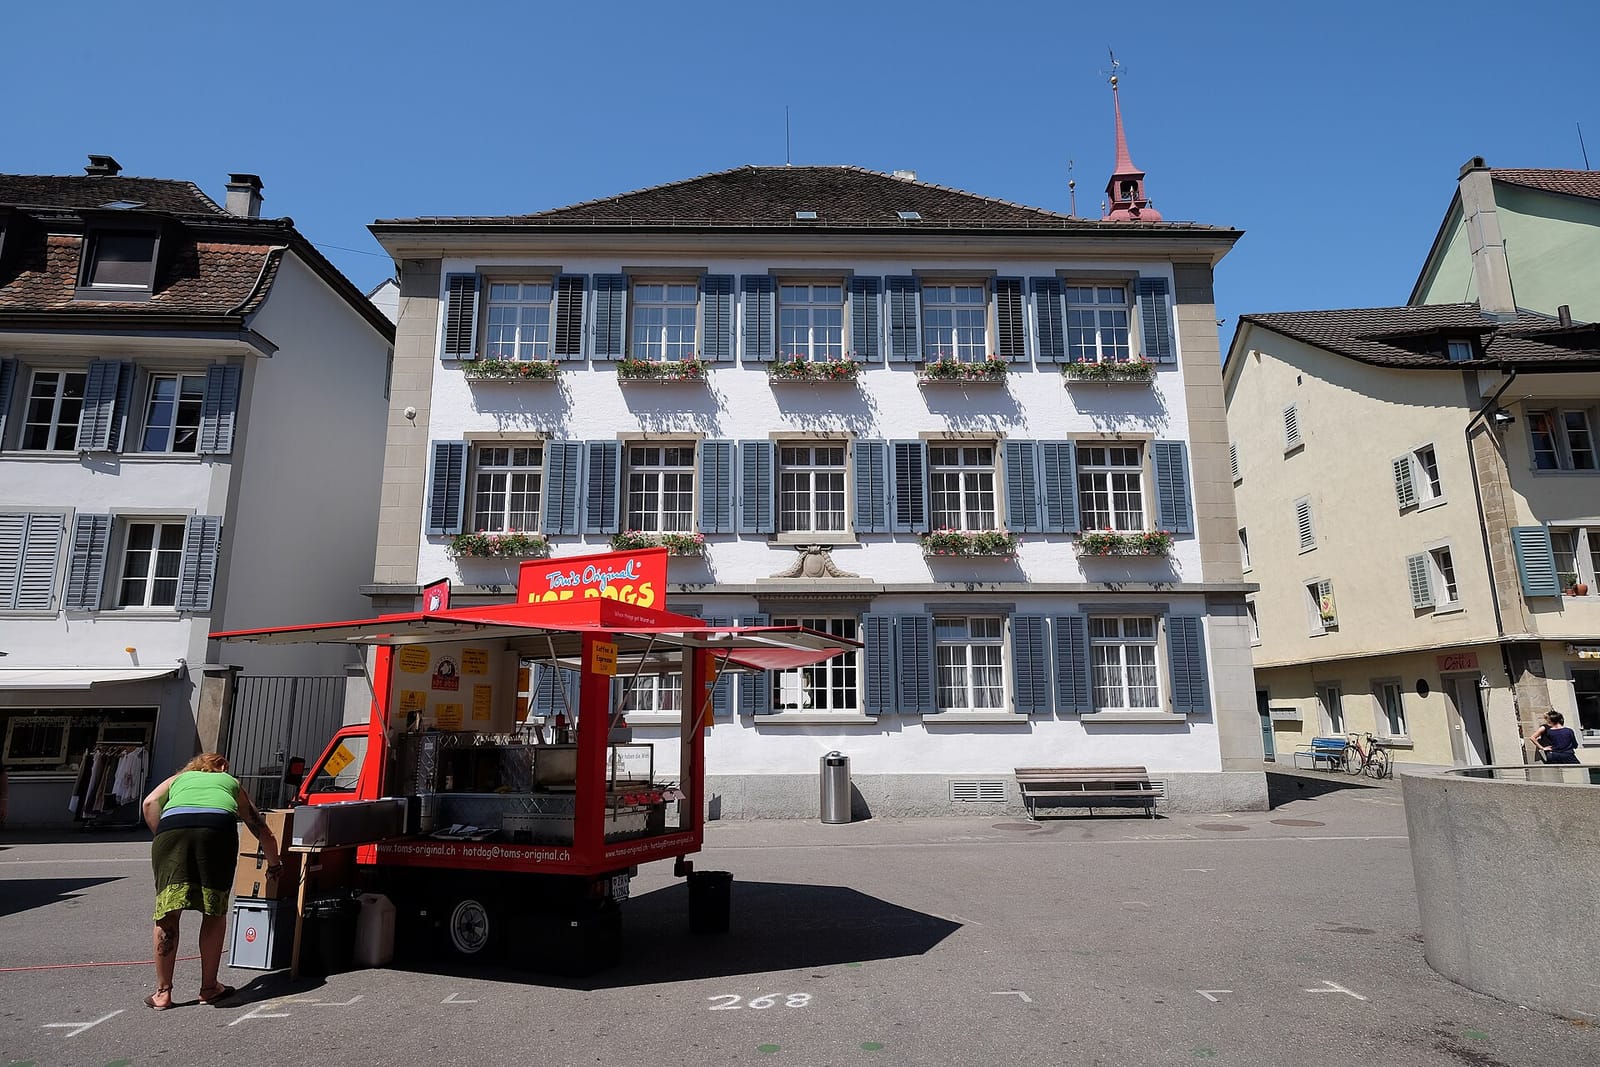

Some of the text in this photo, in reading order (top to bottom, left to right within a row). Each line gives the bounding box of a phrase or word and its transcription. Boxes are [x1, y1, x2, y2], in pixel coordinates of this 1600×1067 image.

[546, 559, 640, 592] Tom's Original
[462, 845, 571, 863] hotdog@toms-original.ch
[707, 993, 813, 1010] 268
